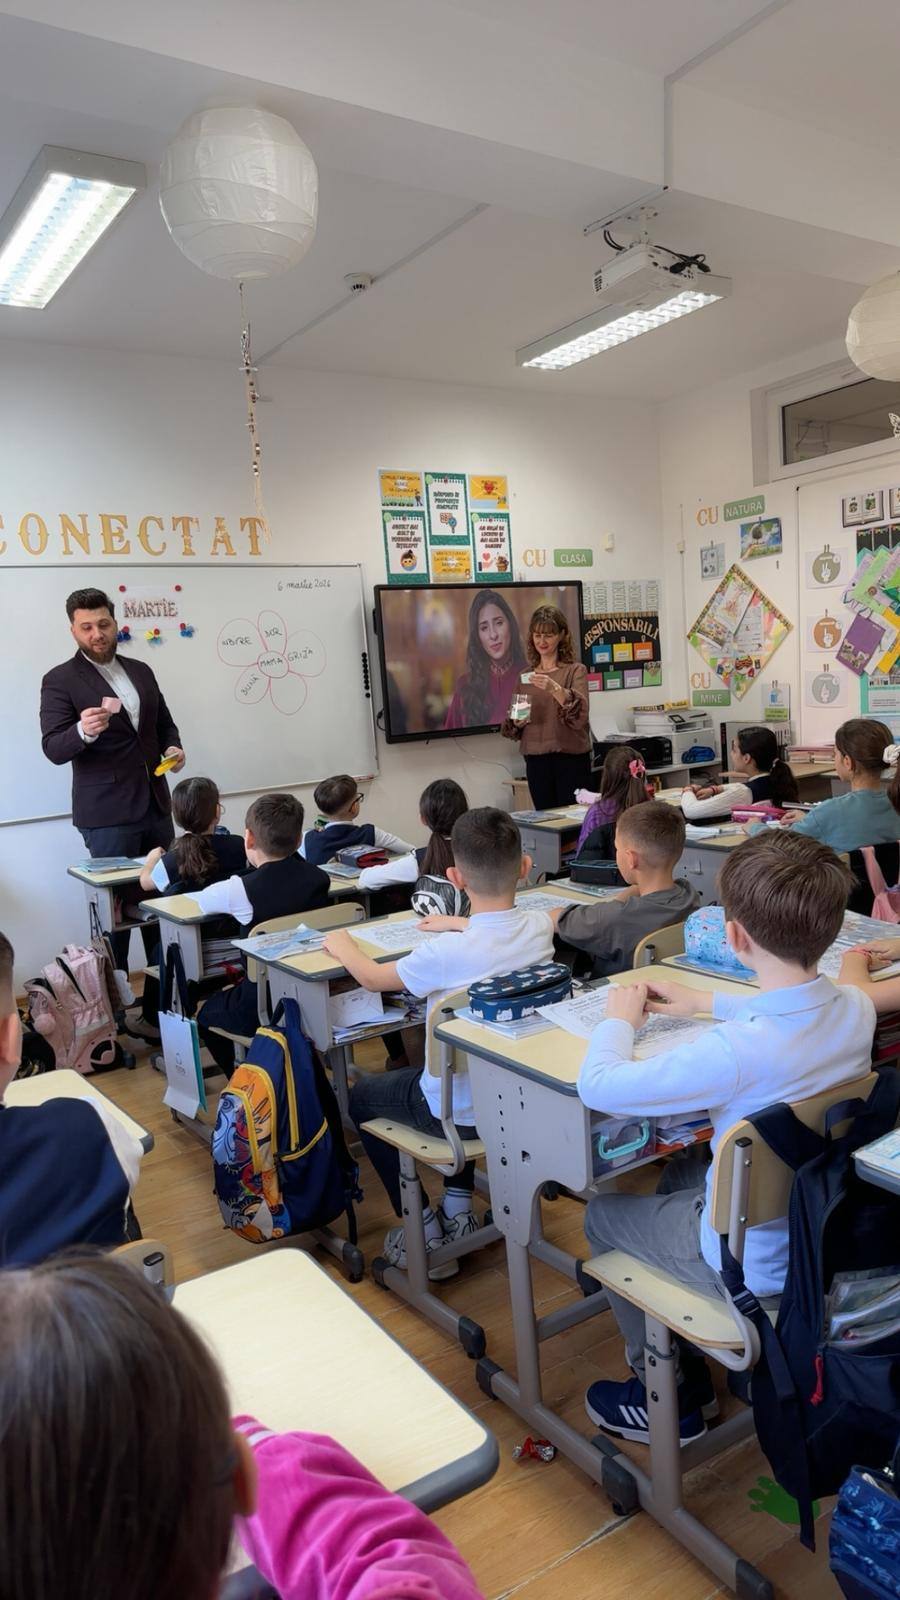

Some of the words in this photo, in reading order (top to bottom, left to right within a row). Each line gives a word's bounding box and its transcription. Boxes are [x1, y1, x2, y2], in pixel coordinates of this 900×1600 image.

[696, 506, 718, 526] CU
[726, 502, 762, 518] NATURA
[0, 513, 264, 556] ONECTAT
[523, 549, 546, 567] CU
[560, 553, 587, 564] CLASA
[260, 657, 283, 667] MAMA
[691, 672, 711, 689] CU
[700, 694, 722, 704] MINE
